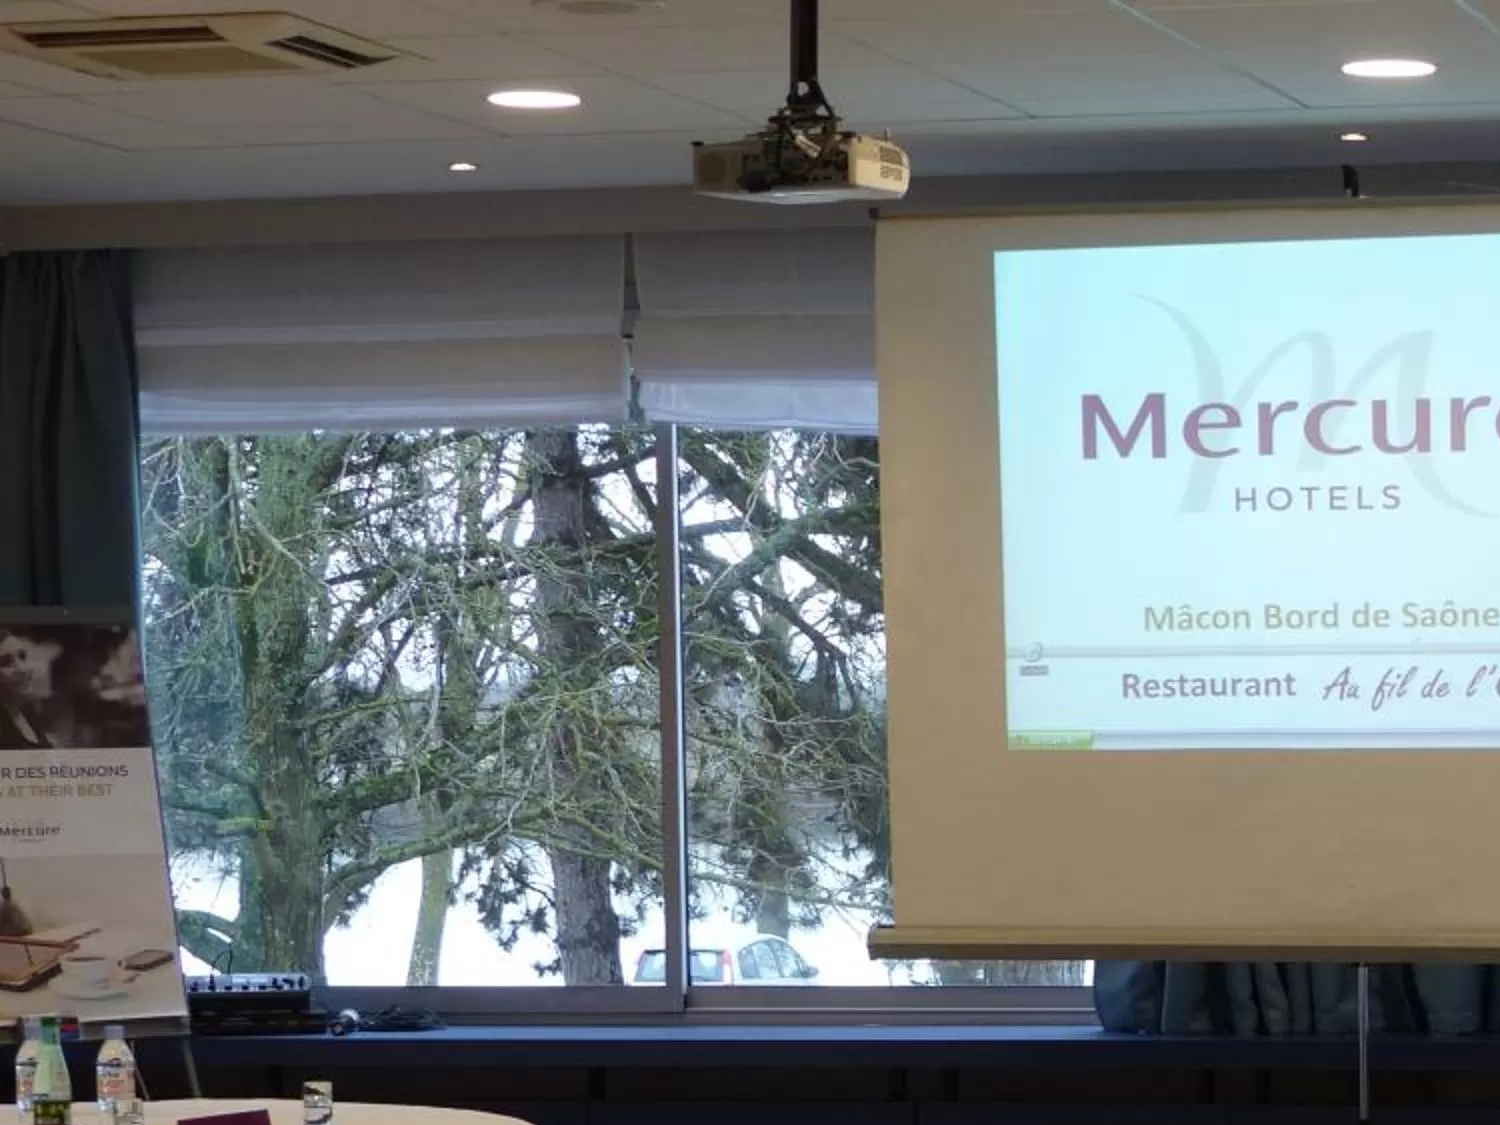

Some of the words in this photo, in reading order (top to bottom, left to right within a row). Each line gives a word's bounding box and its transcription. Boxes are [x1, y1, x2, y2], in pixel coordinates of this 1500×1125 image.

[1234, 484, 1402, 512] HOTELS
[1143, 603, 1251, 632] Mâcon
[1263, 602, 1340, 630] Bord
[1351, 601, 1391, 629] de
[1401, 600, 1500, 628] Saône
[1121, 672, 1297, 700] Restaurant
[1322, 667, 1361, 701] Au
[1371, 666, 1414, 711] fil
[1420, 669, 1451, 700] de
[15, 766, 46, 779] DES
[7, 786, 25, 797] AT
[30, 784, 73, 797] THEIR
[77, 783, 112, 797] BEST
